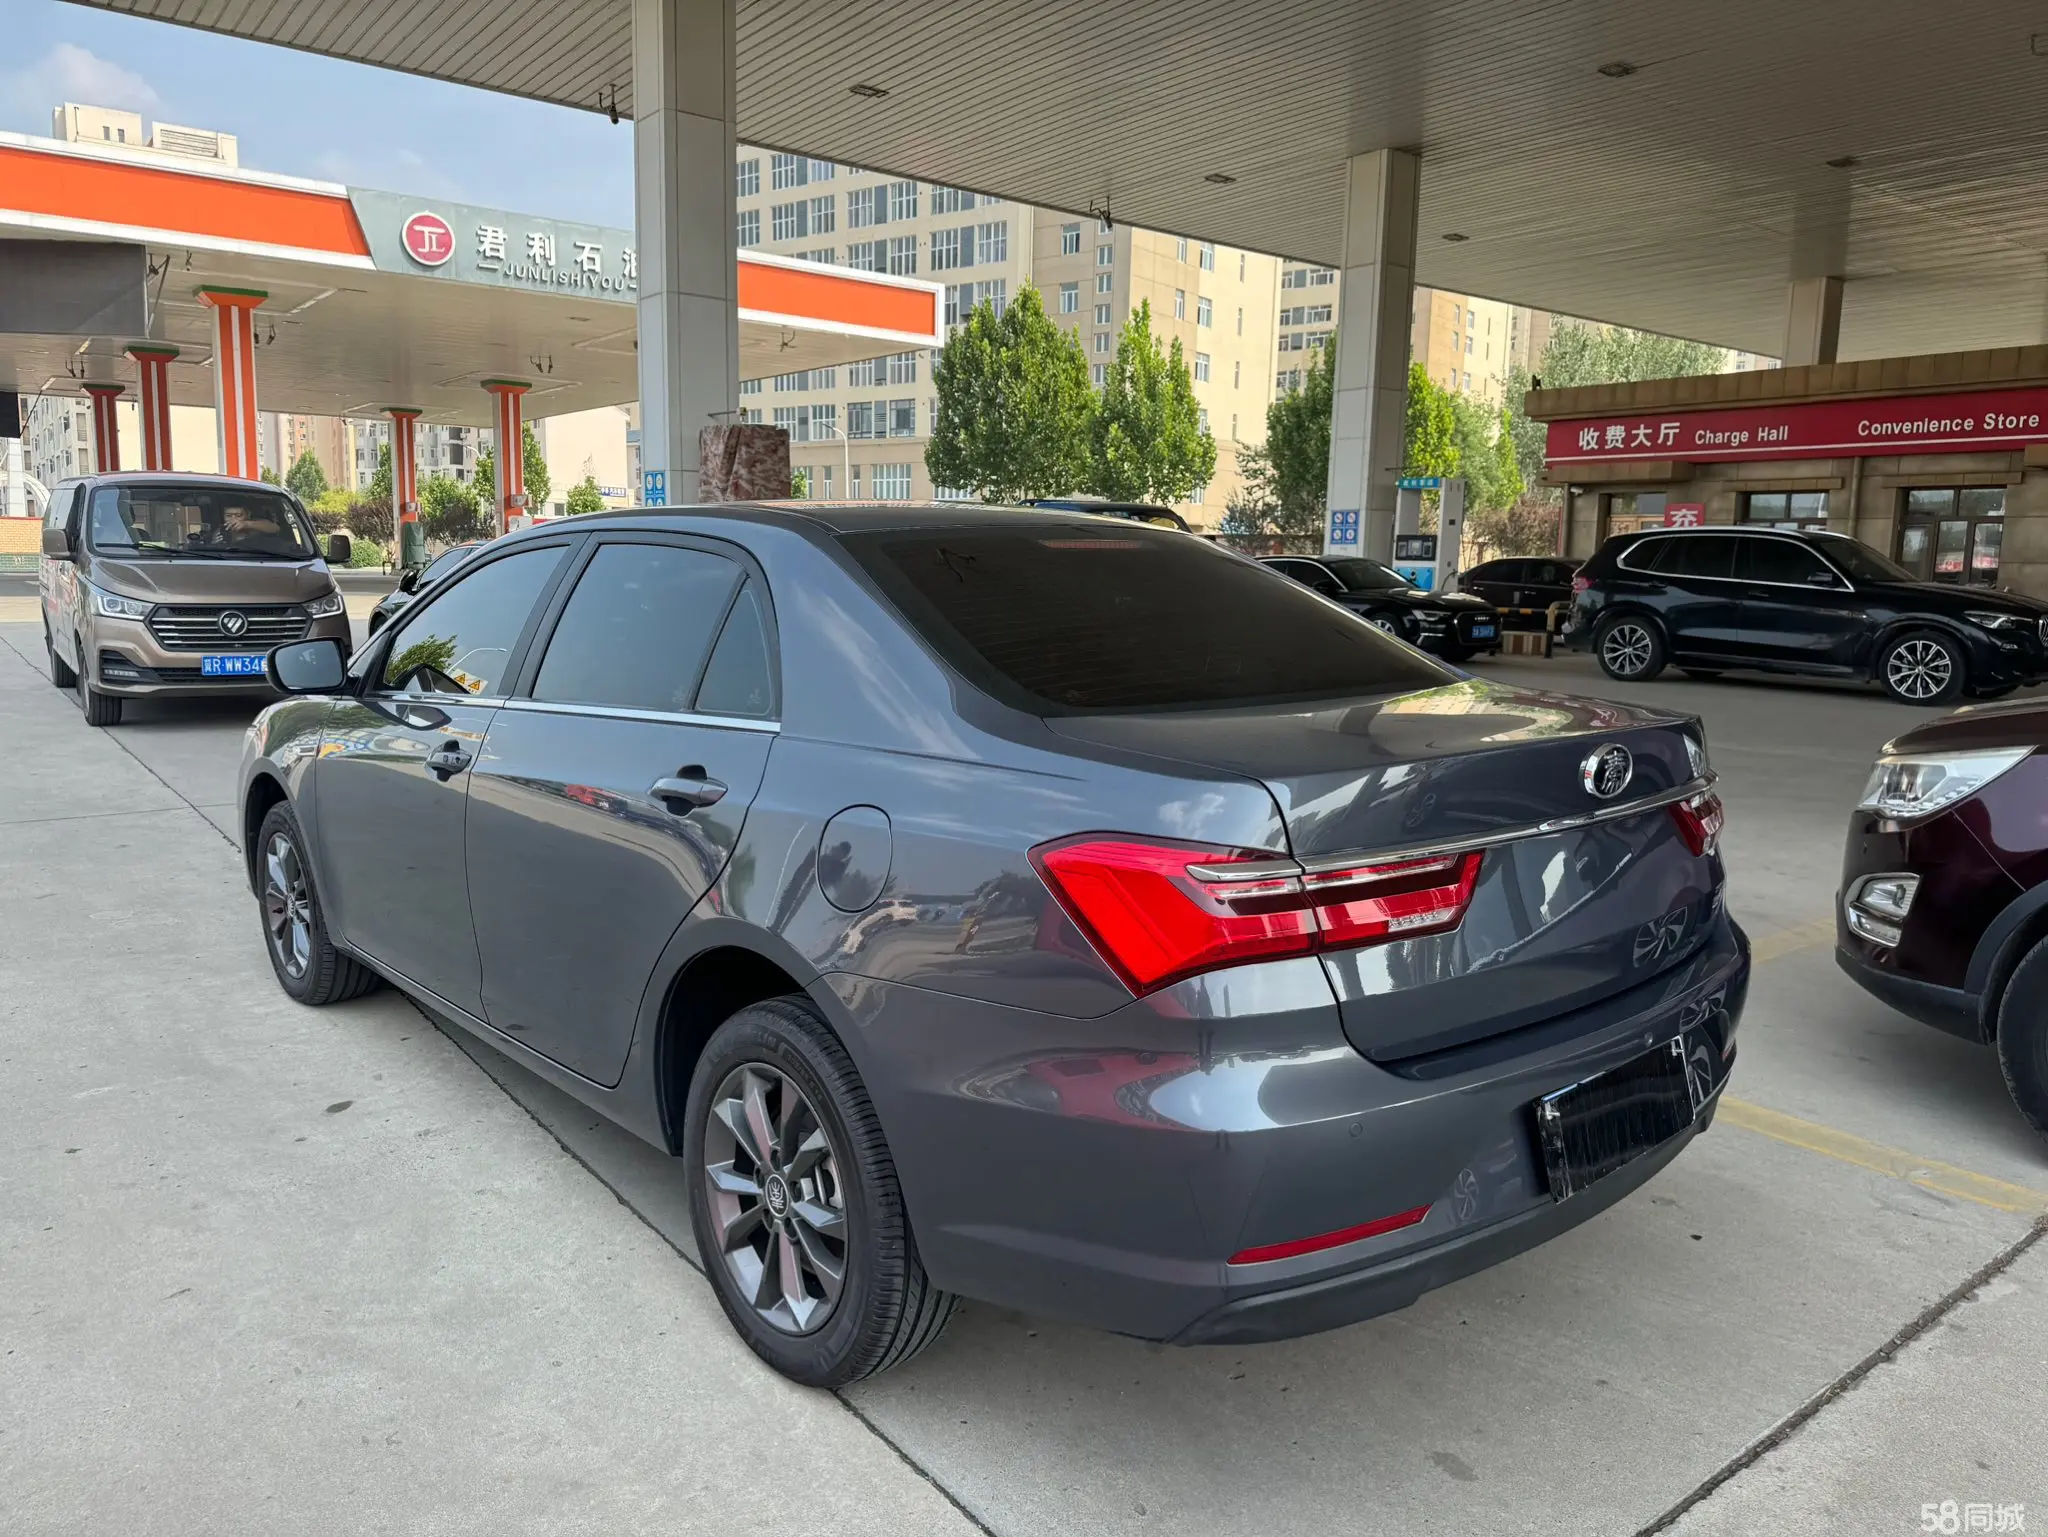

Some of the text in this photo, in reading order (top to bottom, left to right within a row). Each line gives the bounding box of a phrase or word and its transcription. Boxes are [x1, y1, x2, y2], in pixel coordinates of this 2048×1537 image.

[504, 262, 625, 291] JUNLISHIYOU
[1578, 421, 1681, 450] 收费大厅
[1695, 425, 1789, 447] Charge Hall
[1858, 412, 2040, 436] Convenience Store
